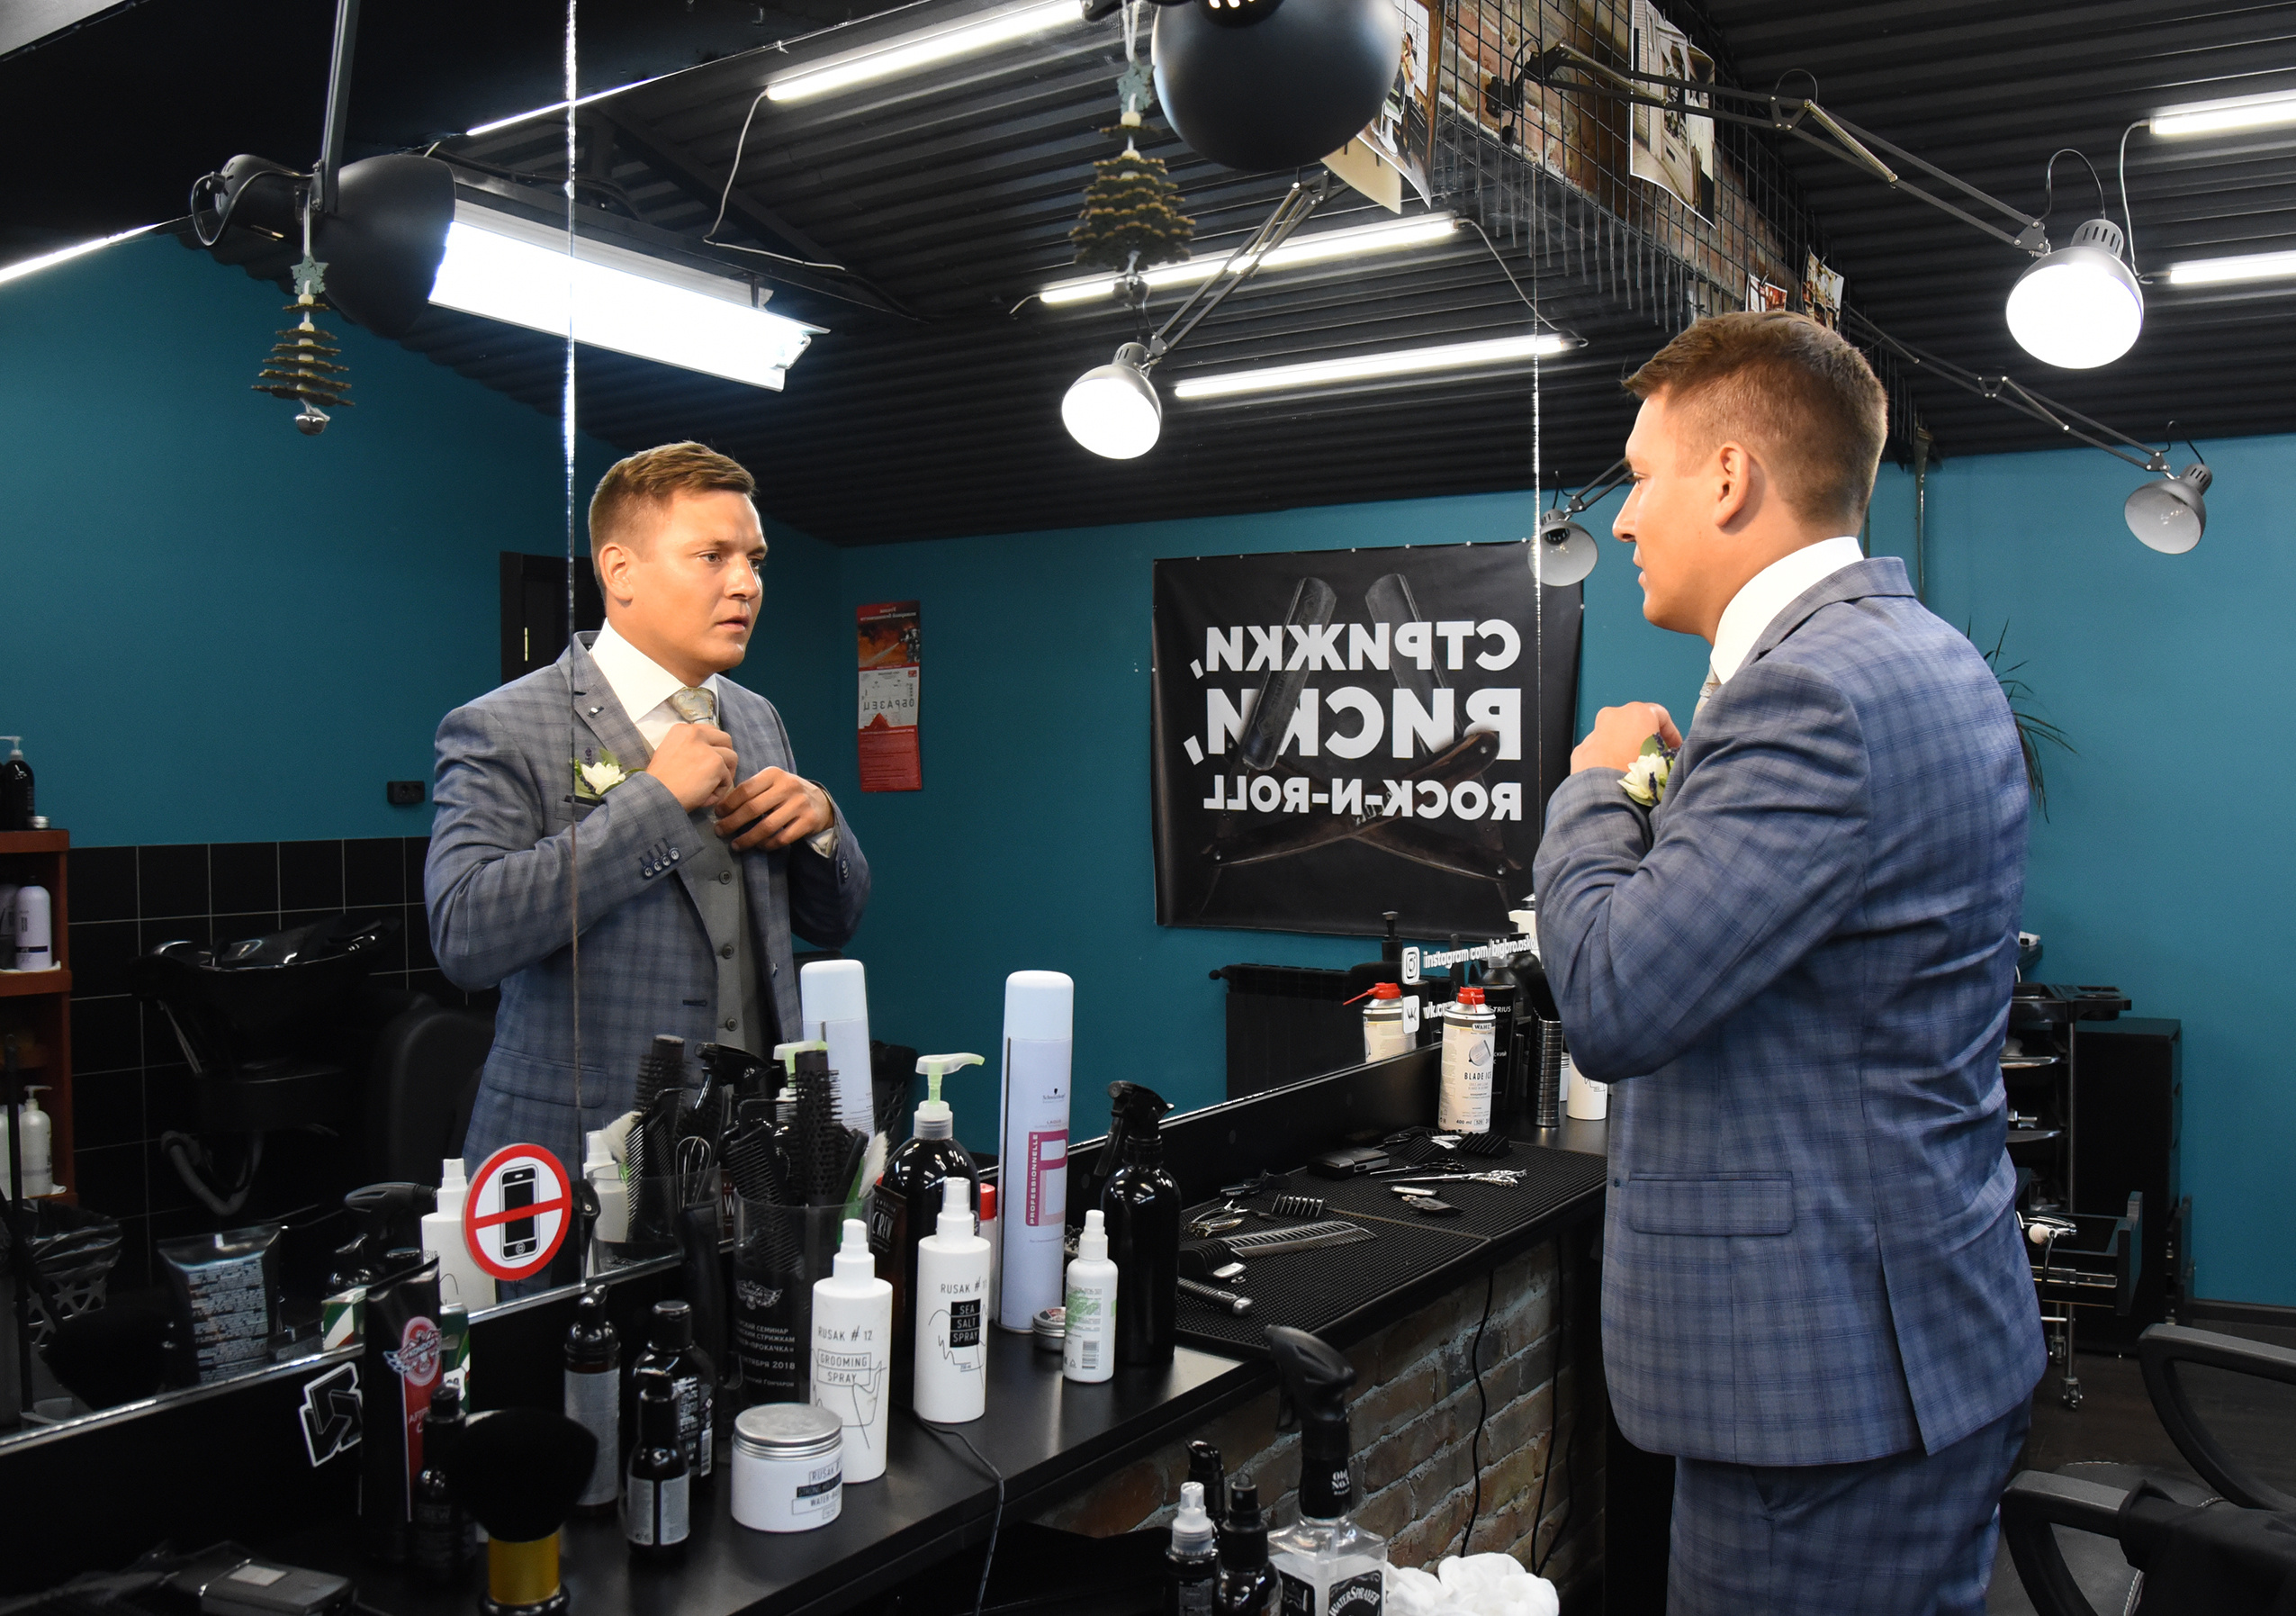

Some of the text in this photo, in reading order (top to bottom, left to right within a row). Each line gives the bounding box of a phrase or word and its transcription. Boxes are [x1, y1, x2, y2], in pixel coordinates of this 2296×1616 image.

[1490, 1006, 1512, 1014] TRIUS
[1463, 1071, 1484, 1080] BLADE
[1030, 1133, 1039, 1224] PROFESSIONNELLE
[940, 1283, 971, 1294] RUSAK
[959, 1305, 975, 1315] SEA
[957, 1317, 977, 1329] SALT
[756, 1324, 789, 1335] СЕМИНАР
[817, 1326, 846, 1341] RUSAK
[864, 1330, 873, 1341] 12
[756, 1333, 796, 1343] СТРИЖКАМ
[952, 1331, 978, 1342] SPRAY
[772, 1360, 796, 1370] 2018
[820, 1353, 868, 1368] GROOMING
[827, 1371, 858, 1384] SPRAY
[1332, 1468, 1348, 1481] Old
